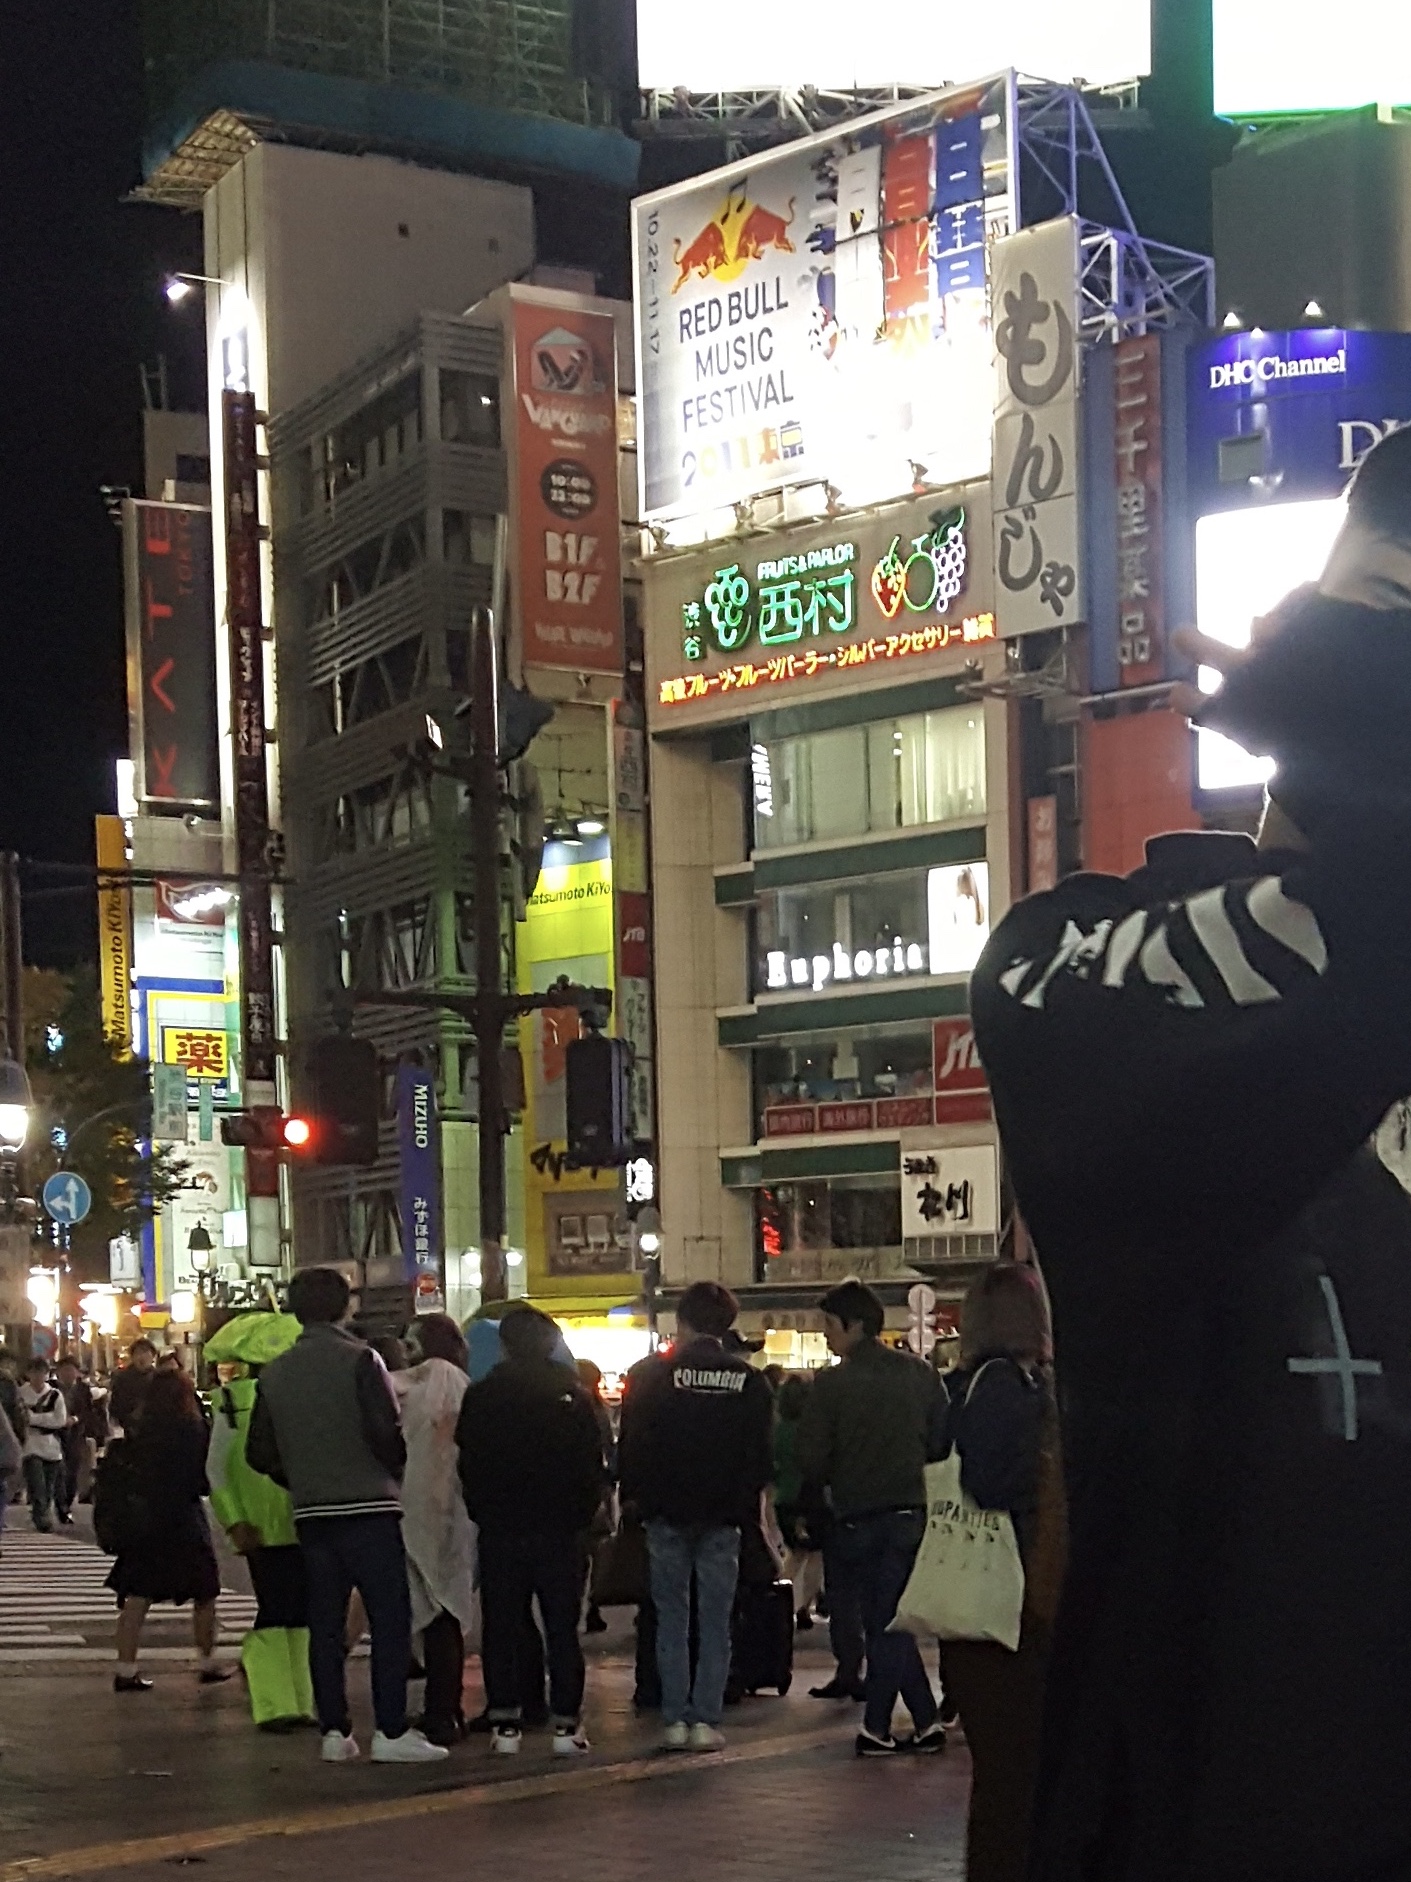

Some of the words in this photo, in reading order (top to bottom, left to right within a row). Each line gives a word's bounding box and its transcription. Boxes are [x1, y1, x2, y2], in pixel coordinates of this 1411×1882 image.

[679, 297, 723, 344] RED
[727, 276, 789, 327] BULL
[695, 326, 774, 382] MUSIC
[1209, 359, 1257, 389] DHC
[1257, 349, 1347, 382] Channel
[682, 369, 795, 433] FESTIVAL
[995, 271, 1076, 618] もんじゃ
[758, 568, 855, 646] 西村
[528, 886, 585, 906] atsumoto
[109, 934, 127, 1039] Matsumoto
[766, 934, 924, 992] Euphoria
[175, 1032, 224, 1074] 薬
[413, 1084, 429, 1149] MIZUHO
